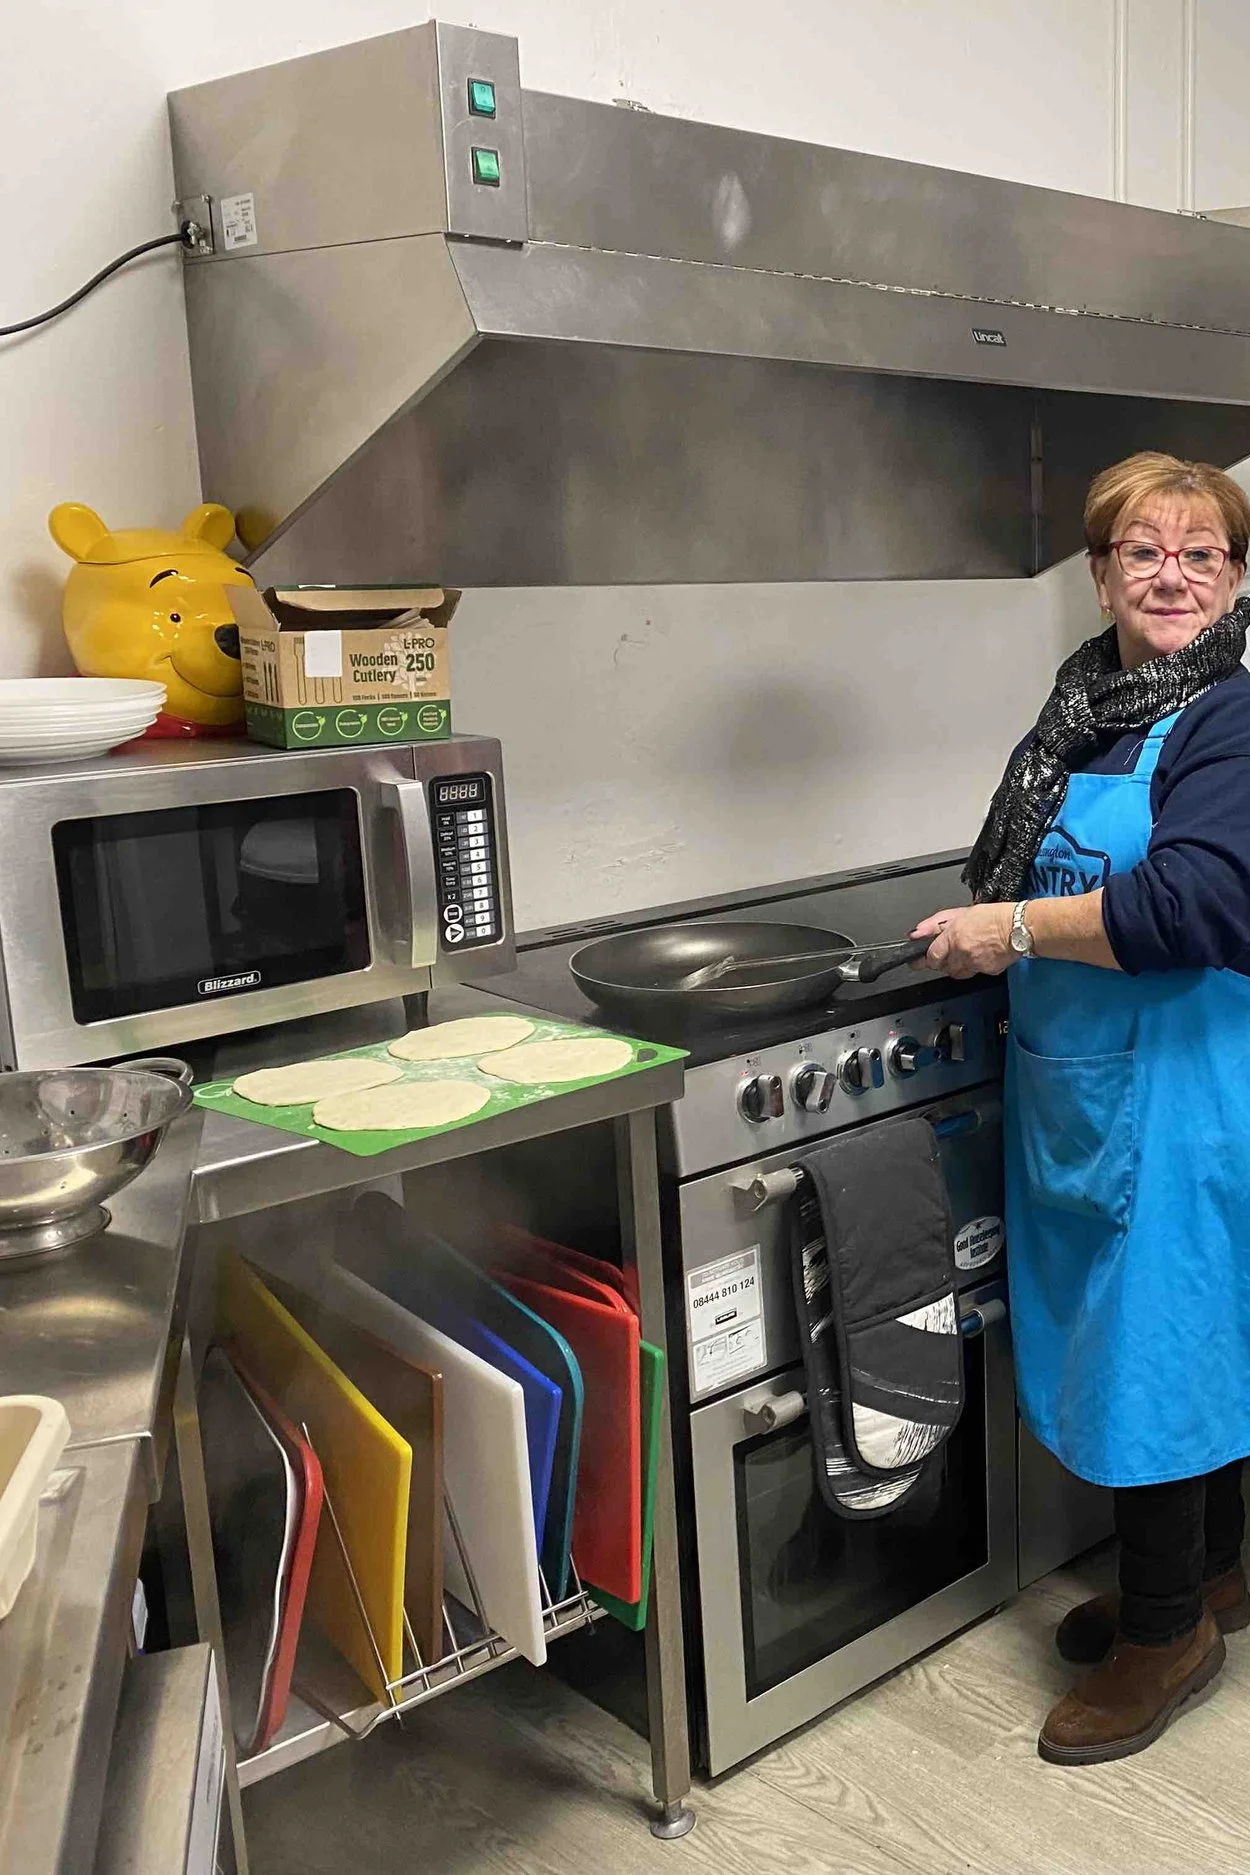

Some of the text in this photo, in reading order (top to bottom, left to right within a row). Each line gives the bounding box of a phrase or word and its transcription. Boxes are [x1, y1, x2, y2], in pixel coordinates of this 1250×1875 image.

[974, 330, 1004, 344] Lincat
[349, 653, 398, 667] Wooden
[406, 653, 435, 672] 250
[353, 669, 397, 683] Cutlery
[204, 973, 255, 992] Blizzard
[693, 1276, 755, 1309] 08444 810 124
